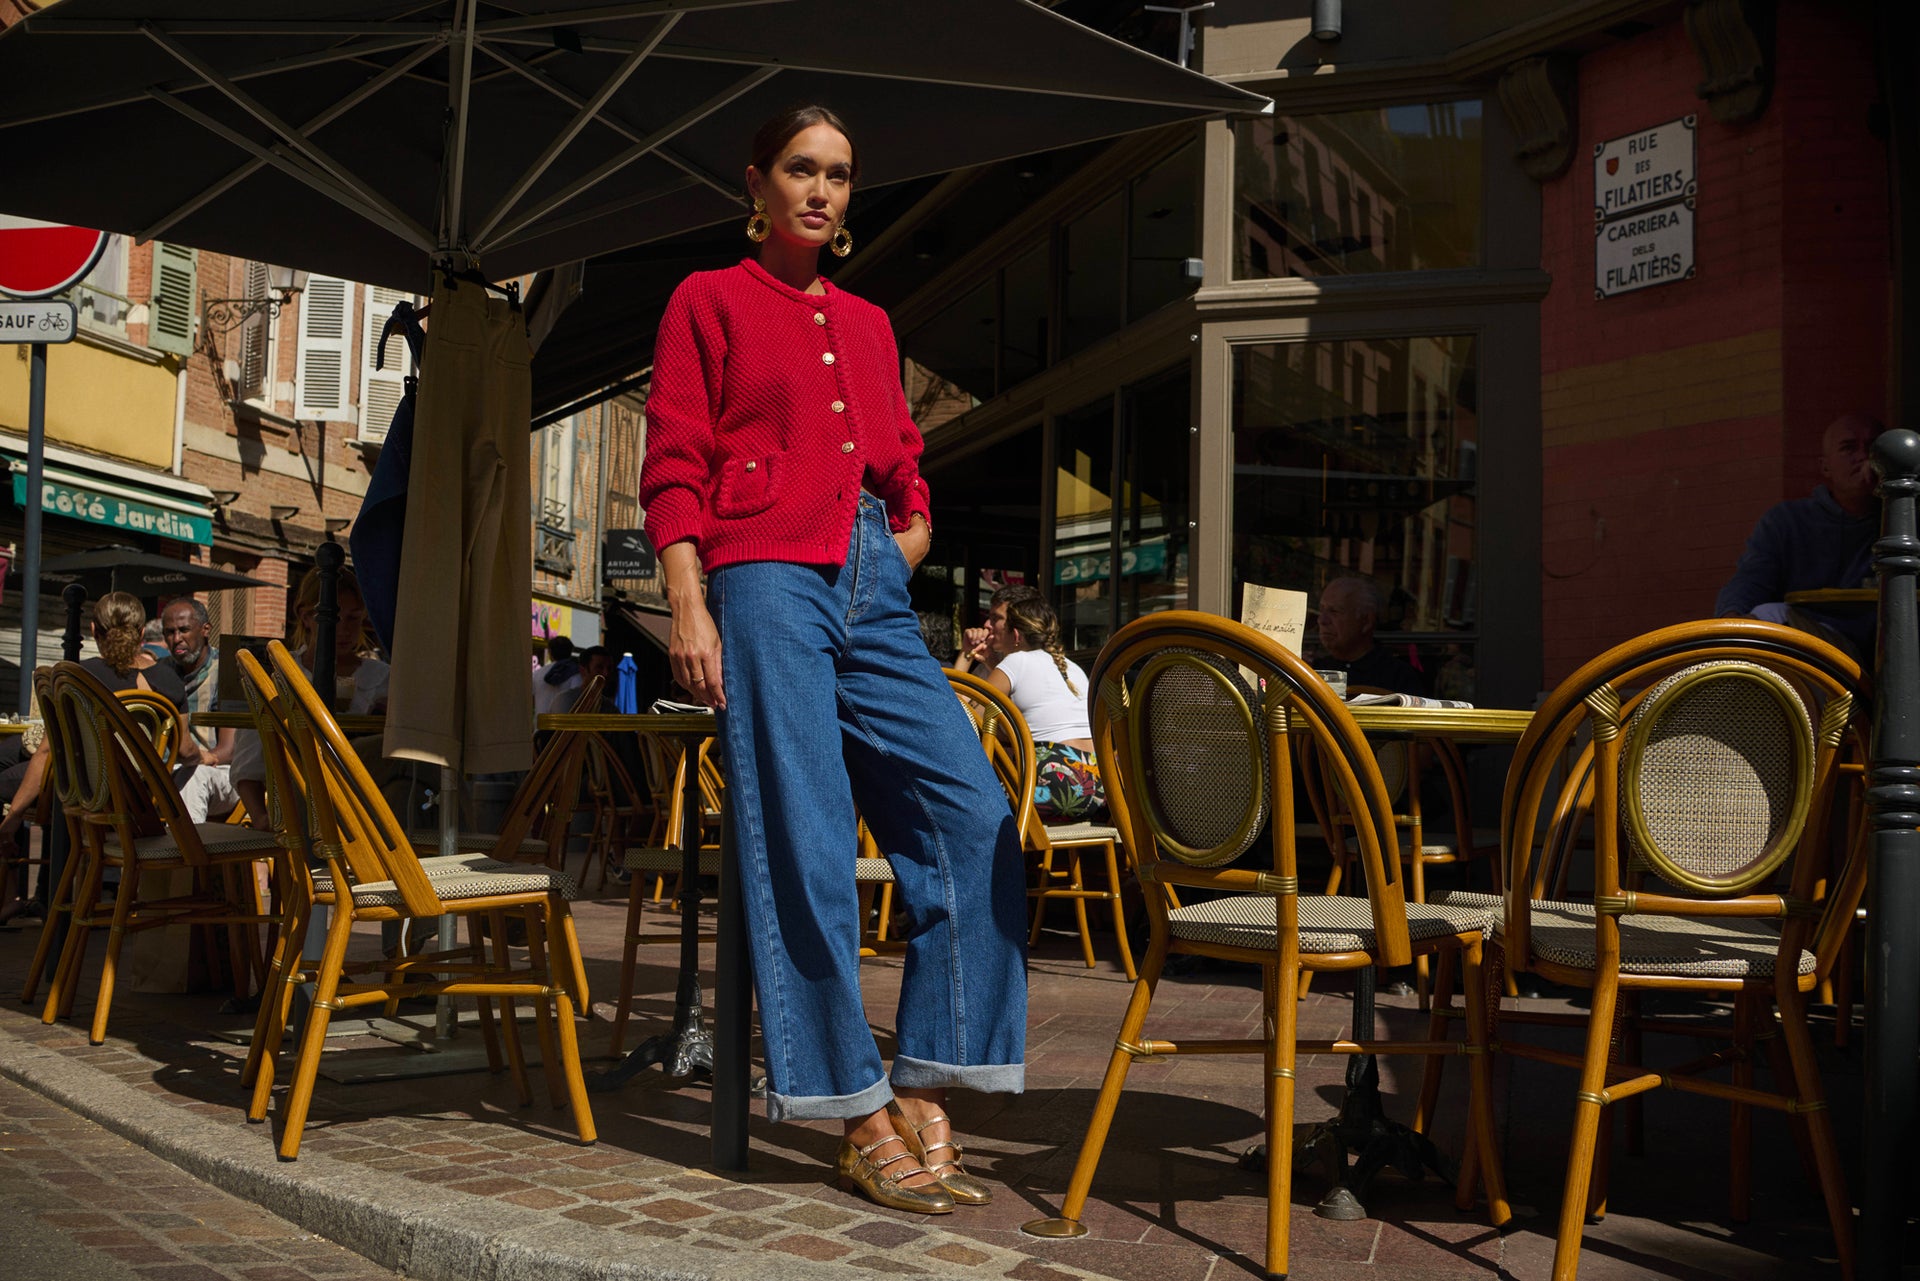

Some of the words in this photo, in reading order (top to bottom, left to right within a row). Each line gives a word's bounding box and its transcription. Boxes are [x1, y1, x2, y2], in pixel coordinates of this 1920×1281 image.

[1628, 133, 1658, 155] RUE
[1635, 159, 1651, 175] DES
[1605, 169, 1684, 210] FILATIERS
[1607, 211, 1680, 242] CARRIERA
[1632, 243, 1655, 257] DELS
[1606, 253, 1681, 289] FILATIÈRS
[41, 485, 106, 520] Côté
[114, 502, 195, 540] Jardin
[606, 568, 651, 576] BOULANGER
[607, 560, 640, 568] ARTISAN
